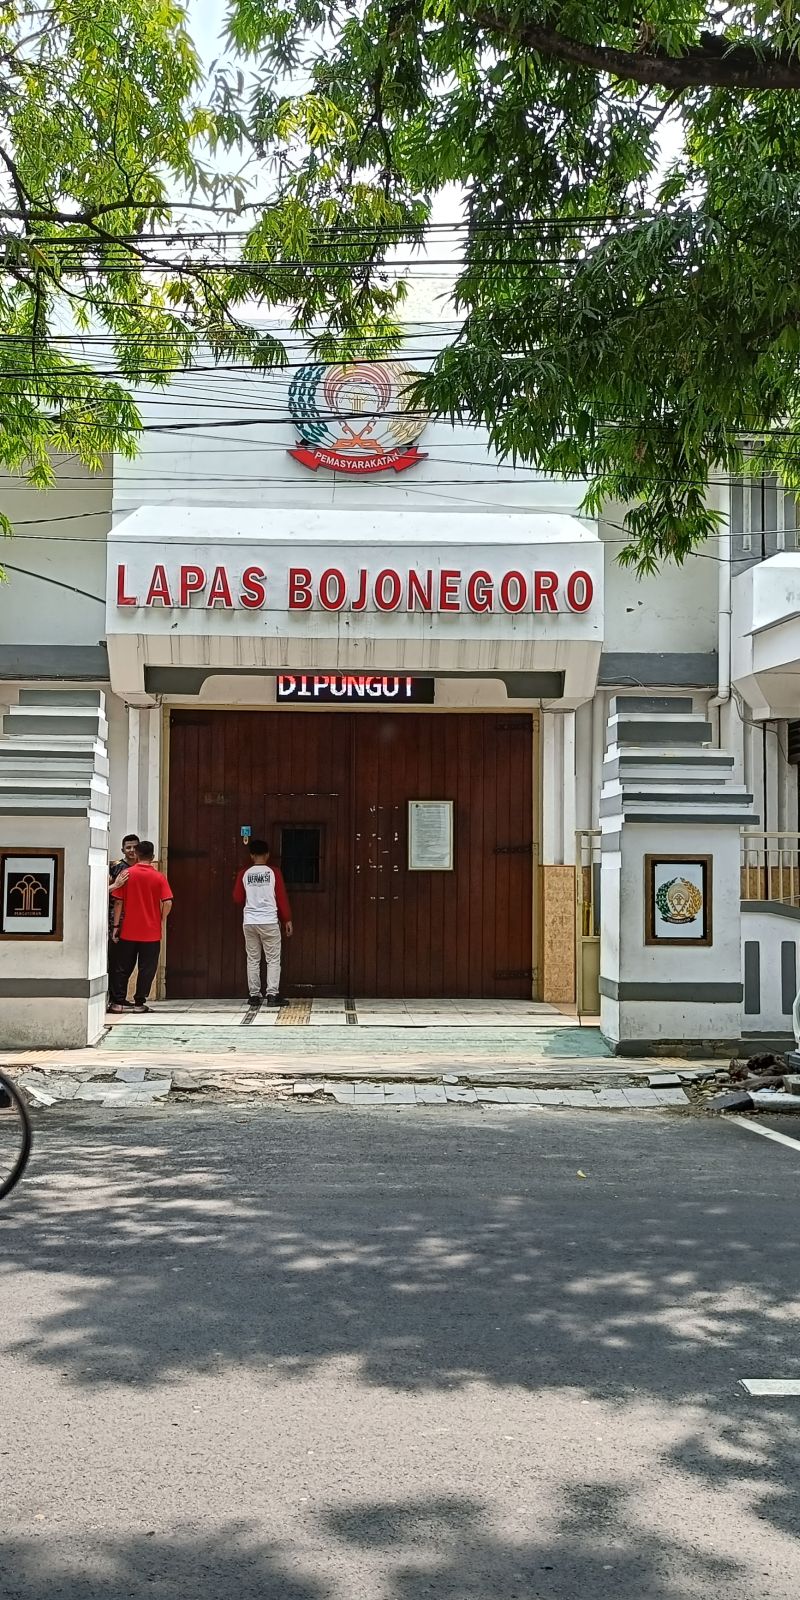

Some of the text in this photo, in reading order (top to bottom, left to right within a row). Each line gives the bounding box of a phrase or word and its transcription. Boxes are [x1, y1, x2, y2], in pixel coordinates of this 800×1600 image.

[314, 451, 400, 469] PEMASYARAKATAN
[116, 564, 594, 614] LAPAS BOJONEGORO
